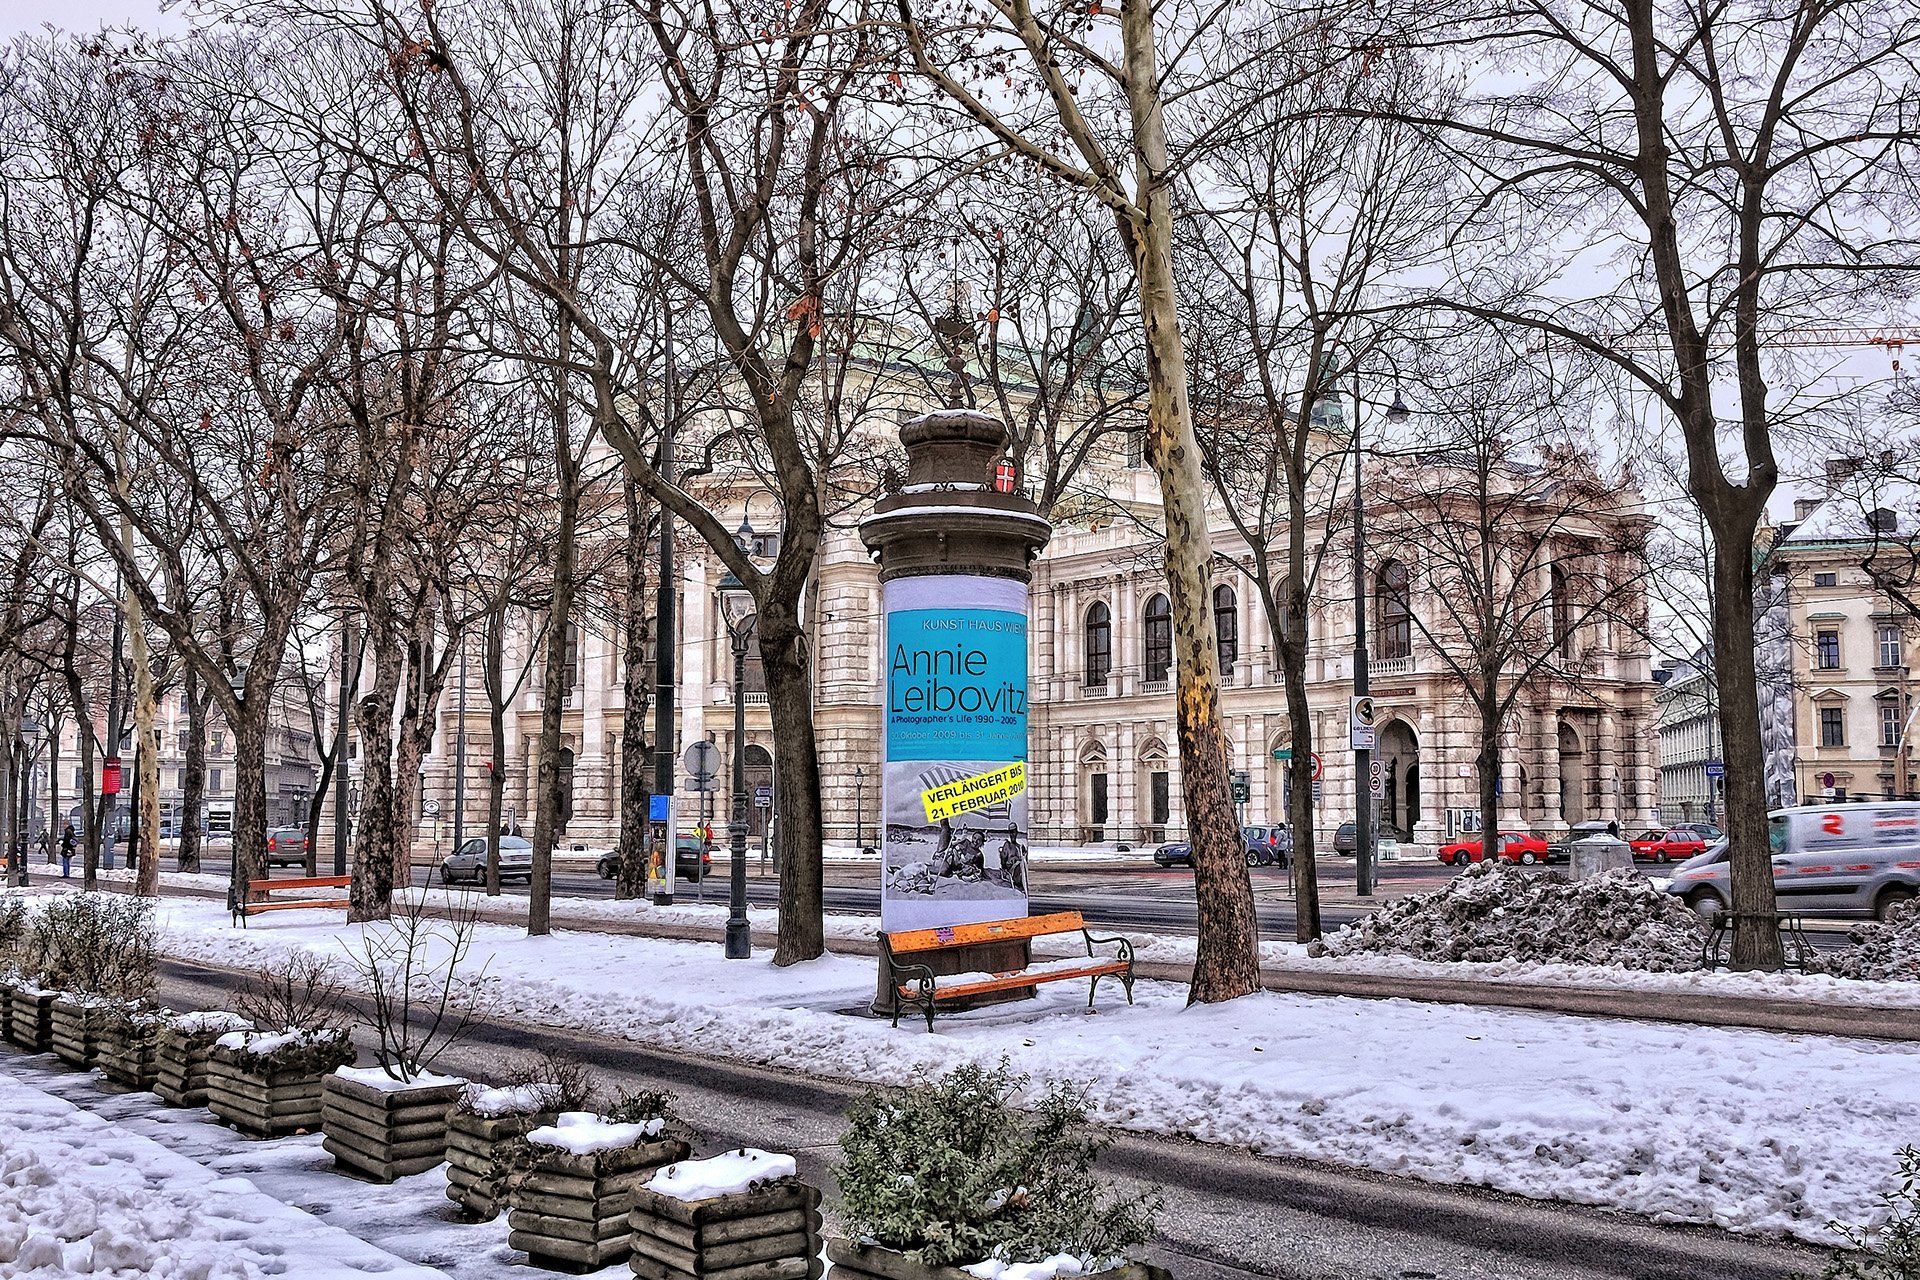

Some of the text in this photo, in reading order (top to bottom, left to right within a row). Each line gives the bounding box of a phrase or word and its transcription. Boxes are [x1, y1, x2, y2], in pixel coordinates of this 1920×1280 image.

[923, 619, 965, 631] KUNST
[969, 620, 1002, 632] HAUS
[891, 643, 988, 677] Annie
[891, 677, 1025, 715] Leibovitz
[891, 716, 896, 724] A
[896, 714, 954, 725] Photographer's
[956, 714, 972, 724] Life
[900, 730, 931, 739] Oktober
[933, 730, 957, 739] 2009
[960, 730, 972, 739] bis
[928, 765, 1023, 804] VERLÄNGERT BIS
[931, 780, 1024, 820] 21. FEBRUAR 2010
